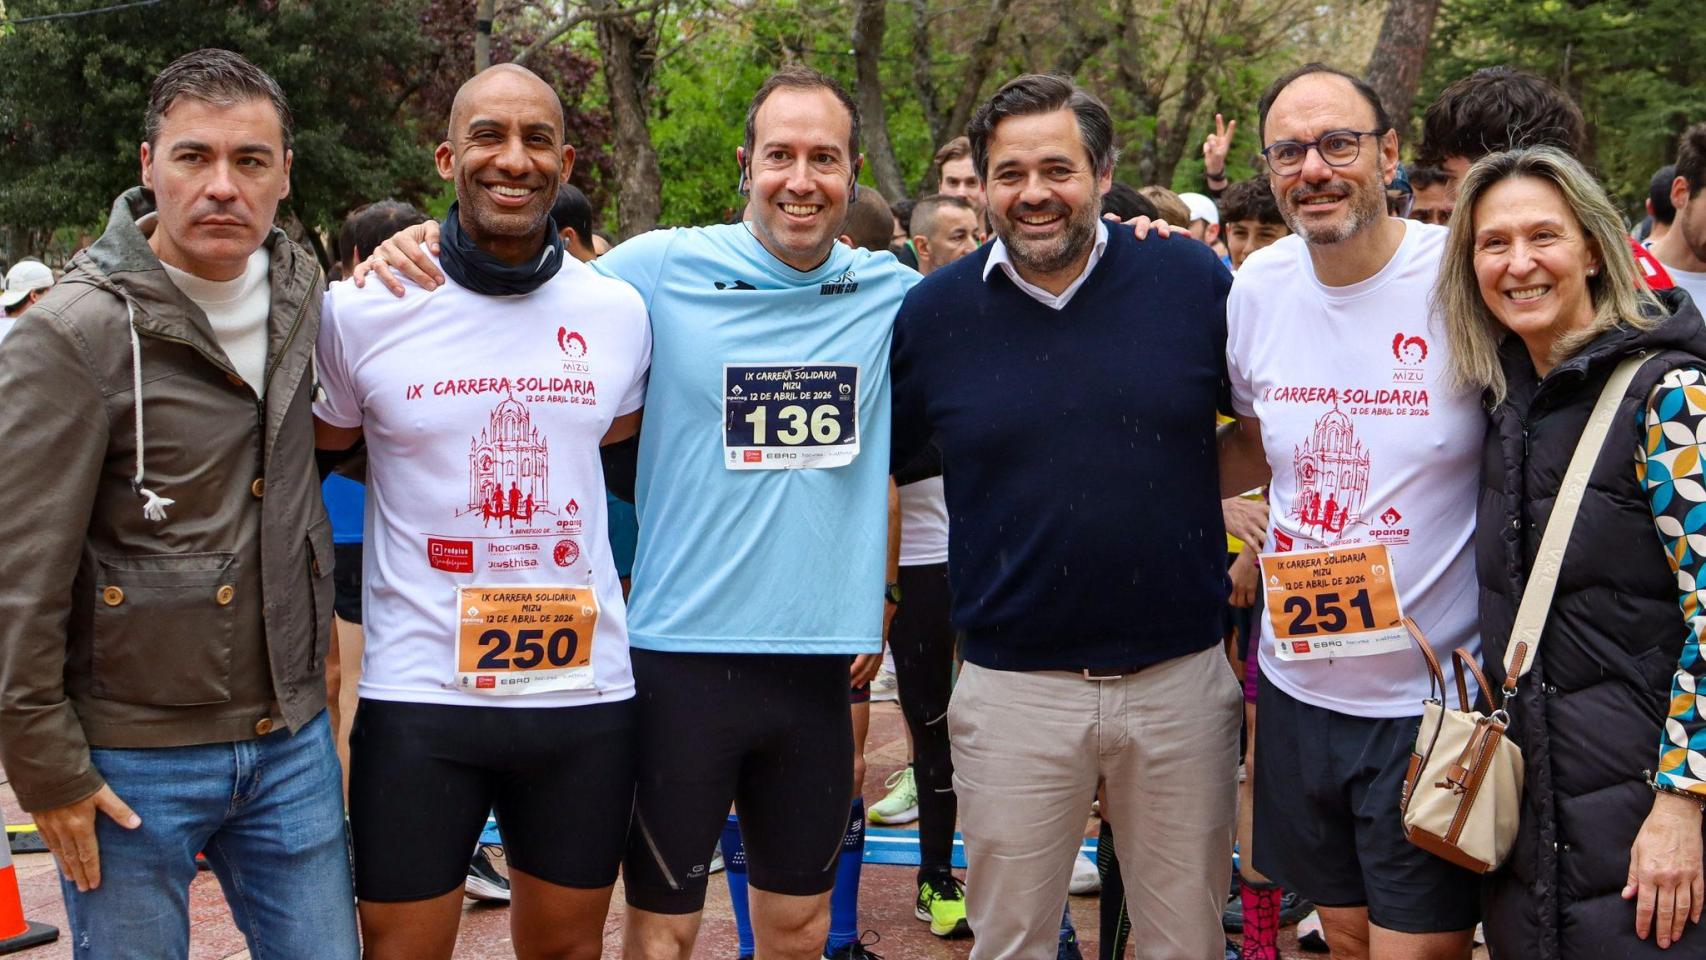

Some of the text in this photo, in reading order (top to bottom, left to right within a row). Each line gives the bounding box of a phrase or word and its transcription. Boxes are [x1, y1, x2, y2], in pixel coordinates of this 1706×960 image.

[745, 371, 837, 381] IX CARRERA SOLIDARIA
[407, 377, 595, 400] IX CARRERA SOLIDARIA
[782, 382, 801, 390] MIZU
[547, 395, 568, 404] ABRIL
[582, 398, 597, 406] 2026
[750, 393, 759, 401] 12
[773, 392, 797, 401] ABRIL
[800, 391, 811, 400] DE
[813, 391, 832, 400] 2026
[1274, 387, 1336, 404] CARRERA
[1342, 388, 1429, 407] SOLIDARIA
[1350, 407, 1430, 416] 12 DE ABRIL DE 2026
[745, 404, 842, 446] 136
[1369, 528, 1410, 538] apanag
[1277, 553, 1367, 570] IX CARRERA SOLIDARIA
[1285, 582, 1292, 591] 12
[1294, 580, 1303, 588] DE
[1306, 577, 1329, 588] ABRIL
[1332, 577, 1343, 586] DE
[1345, 574, 1366, 584] 2026
[481, 593, 576, 602] IX CARRERA SOLIDARIA
[521, 604, 542, 613] MIZU
[1283, 588, 1376, 636] 251
[486, 614, 574, 624] 12 DE ABRIL DE 2026
[476, 627, 578, 670] 250
